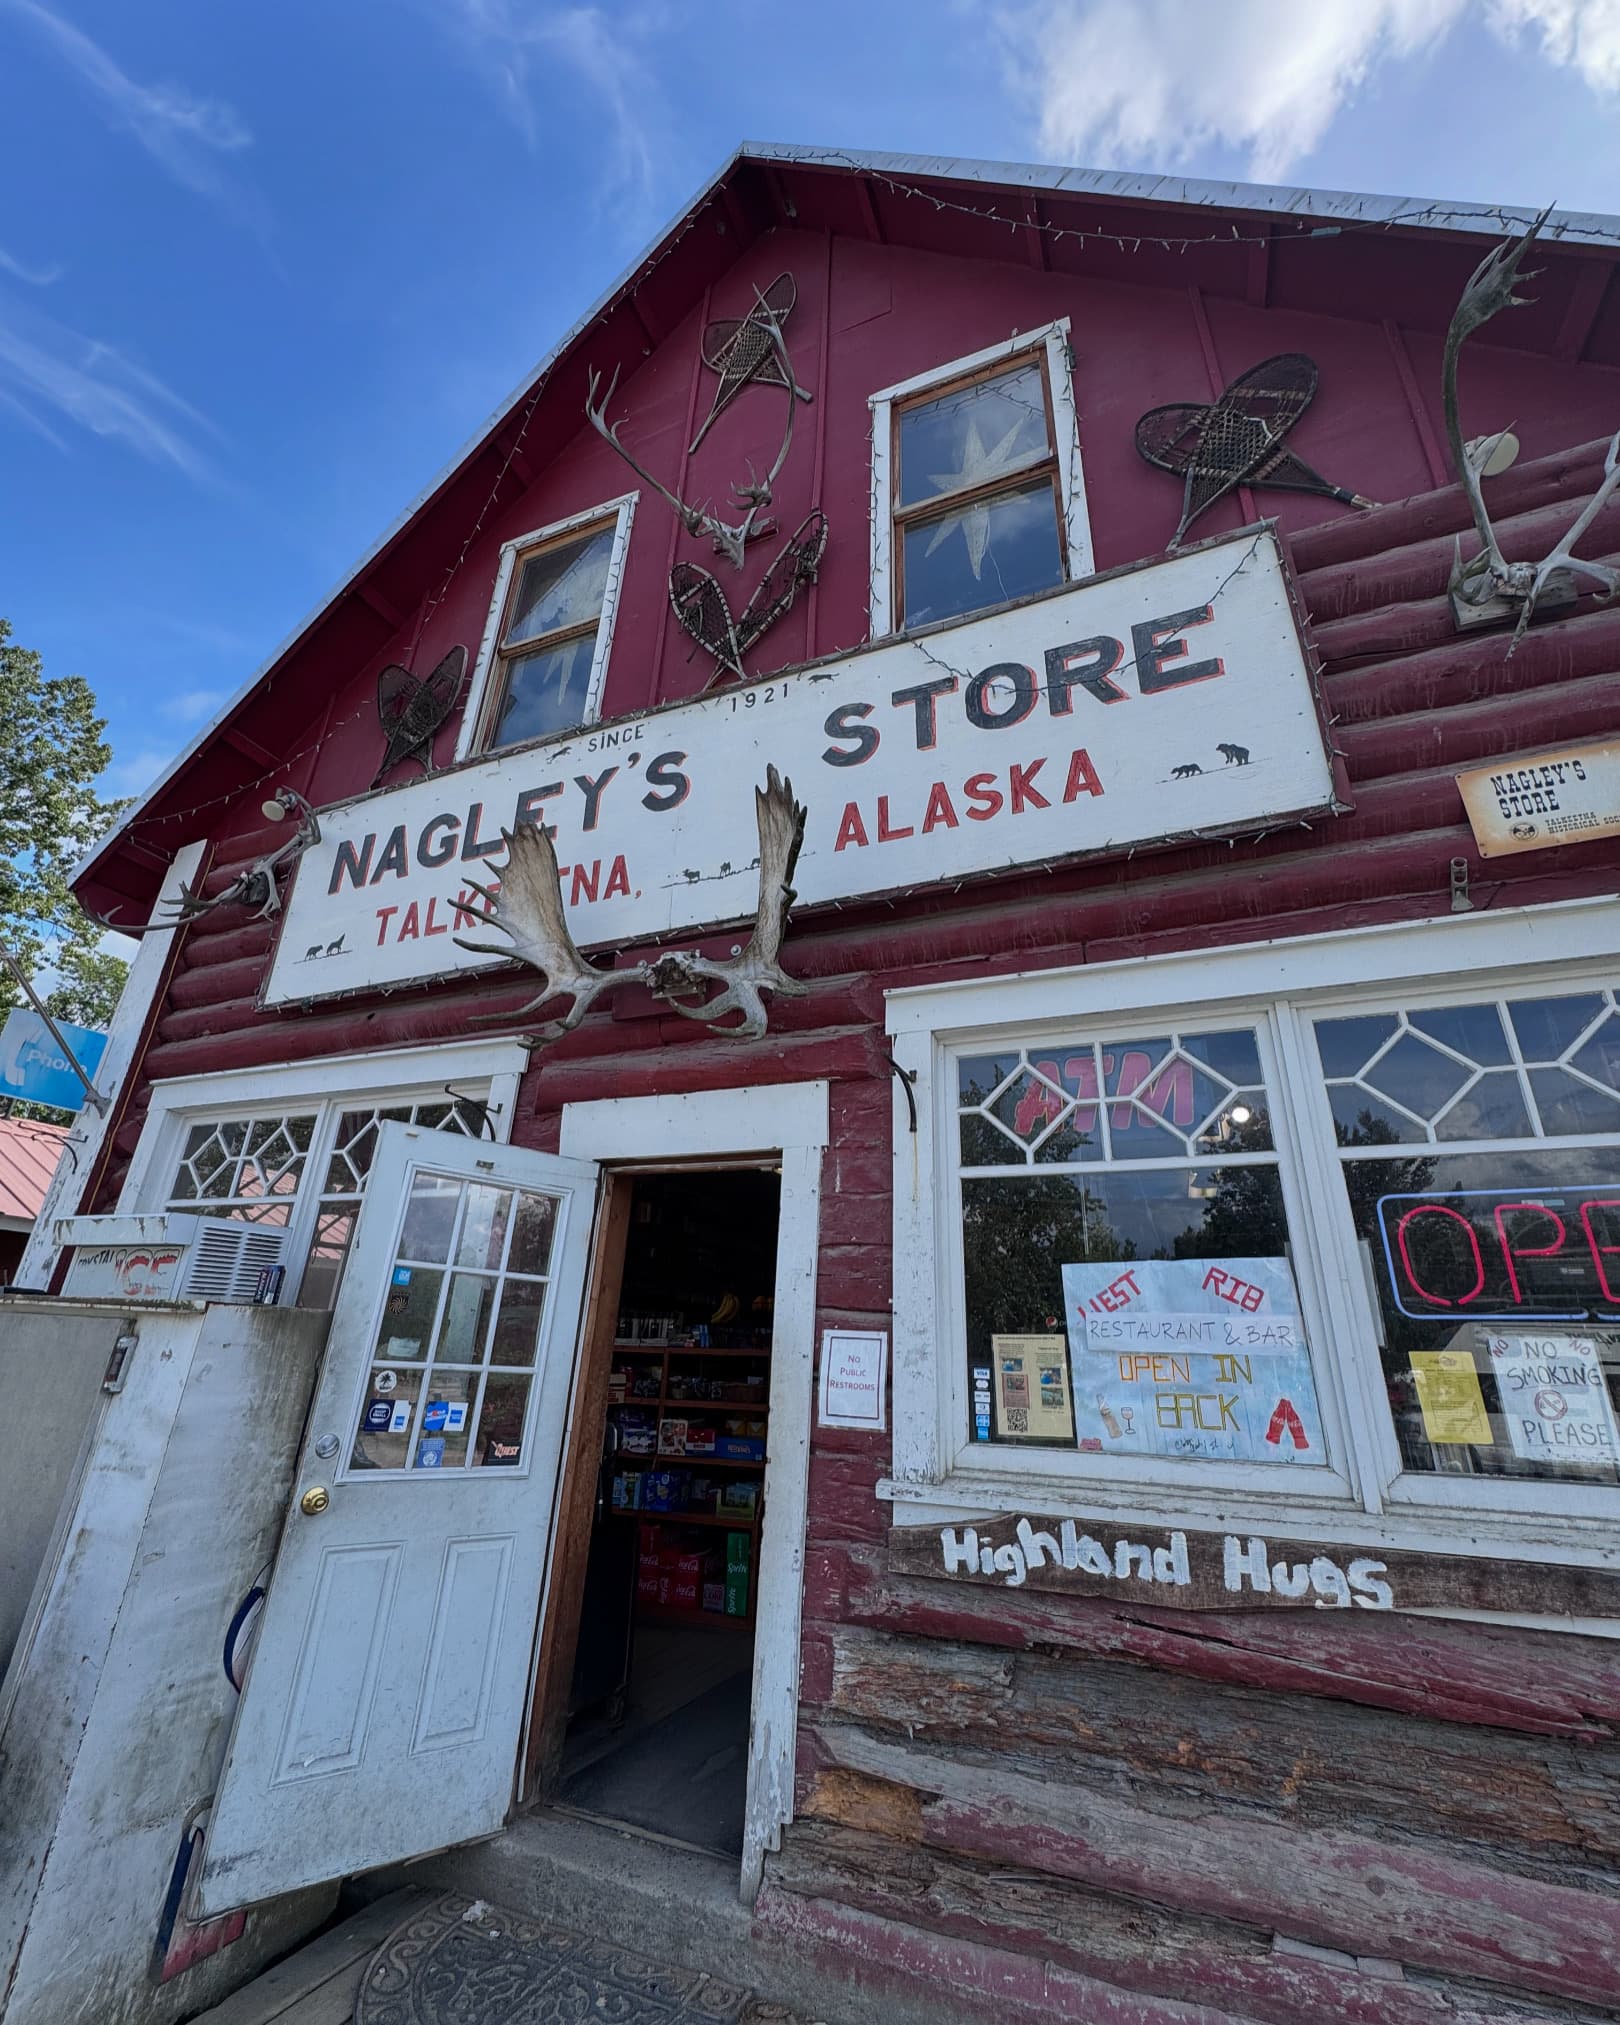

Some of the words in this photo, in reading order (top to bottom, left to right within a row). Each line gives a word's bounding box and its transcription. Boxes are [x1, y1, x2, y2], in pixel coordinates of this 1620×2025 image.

[587, 724, 645, 752] SINCE
[731, 683, 789, 713] 1921
[327, 751, 691, 895] NAGLEY'S
[821, 605, 1226, 768] STORE
[1490, 760, 1586, 796] NAGLEY'S
[834, 748, 1104, 851] ALASKA
[1499, 790, 1560, 819] STORE
[1014, 1052, 1194, 1136] ATM
[1202, 1266, 1264, 1312] RIB
[1090, 1320, 1215, 1340] RESTAURANT
[1224, 1323, 1243, 1345] &
[1246, 1325, 1294, 1346] BAR
[1569, 1339, 1591, 1356] NO
[847, 1355, 860, 1364] NO
[1493, 1339, 1509, 1358] NO
[1525, 1341, 1557, 1359] NO
[1119, 1355, 1190, 1383] OPEN
[1212, 1354, 1252, 1384] IN
[1507, 1363, 1602, 1391] SMOKING
[830, 1380, 875, 1391] RESTROOMS
[1155, 1393, 1241, 1431] BACK
[1522, 1420, 1612, 1446] PLEASE
[941, 1519, 1191, 1585] Highland
[1224, 1535, 1393, 1608] Hugs
